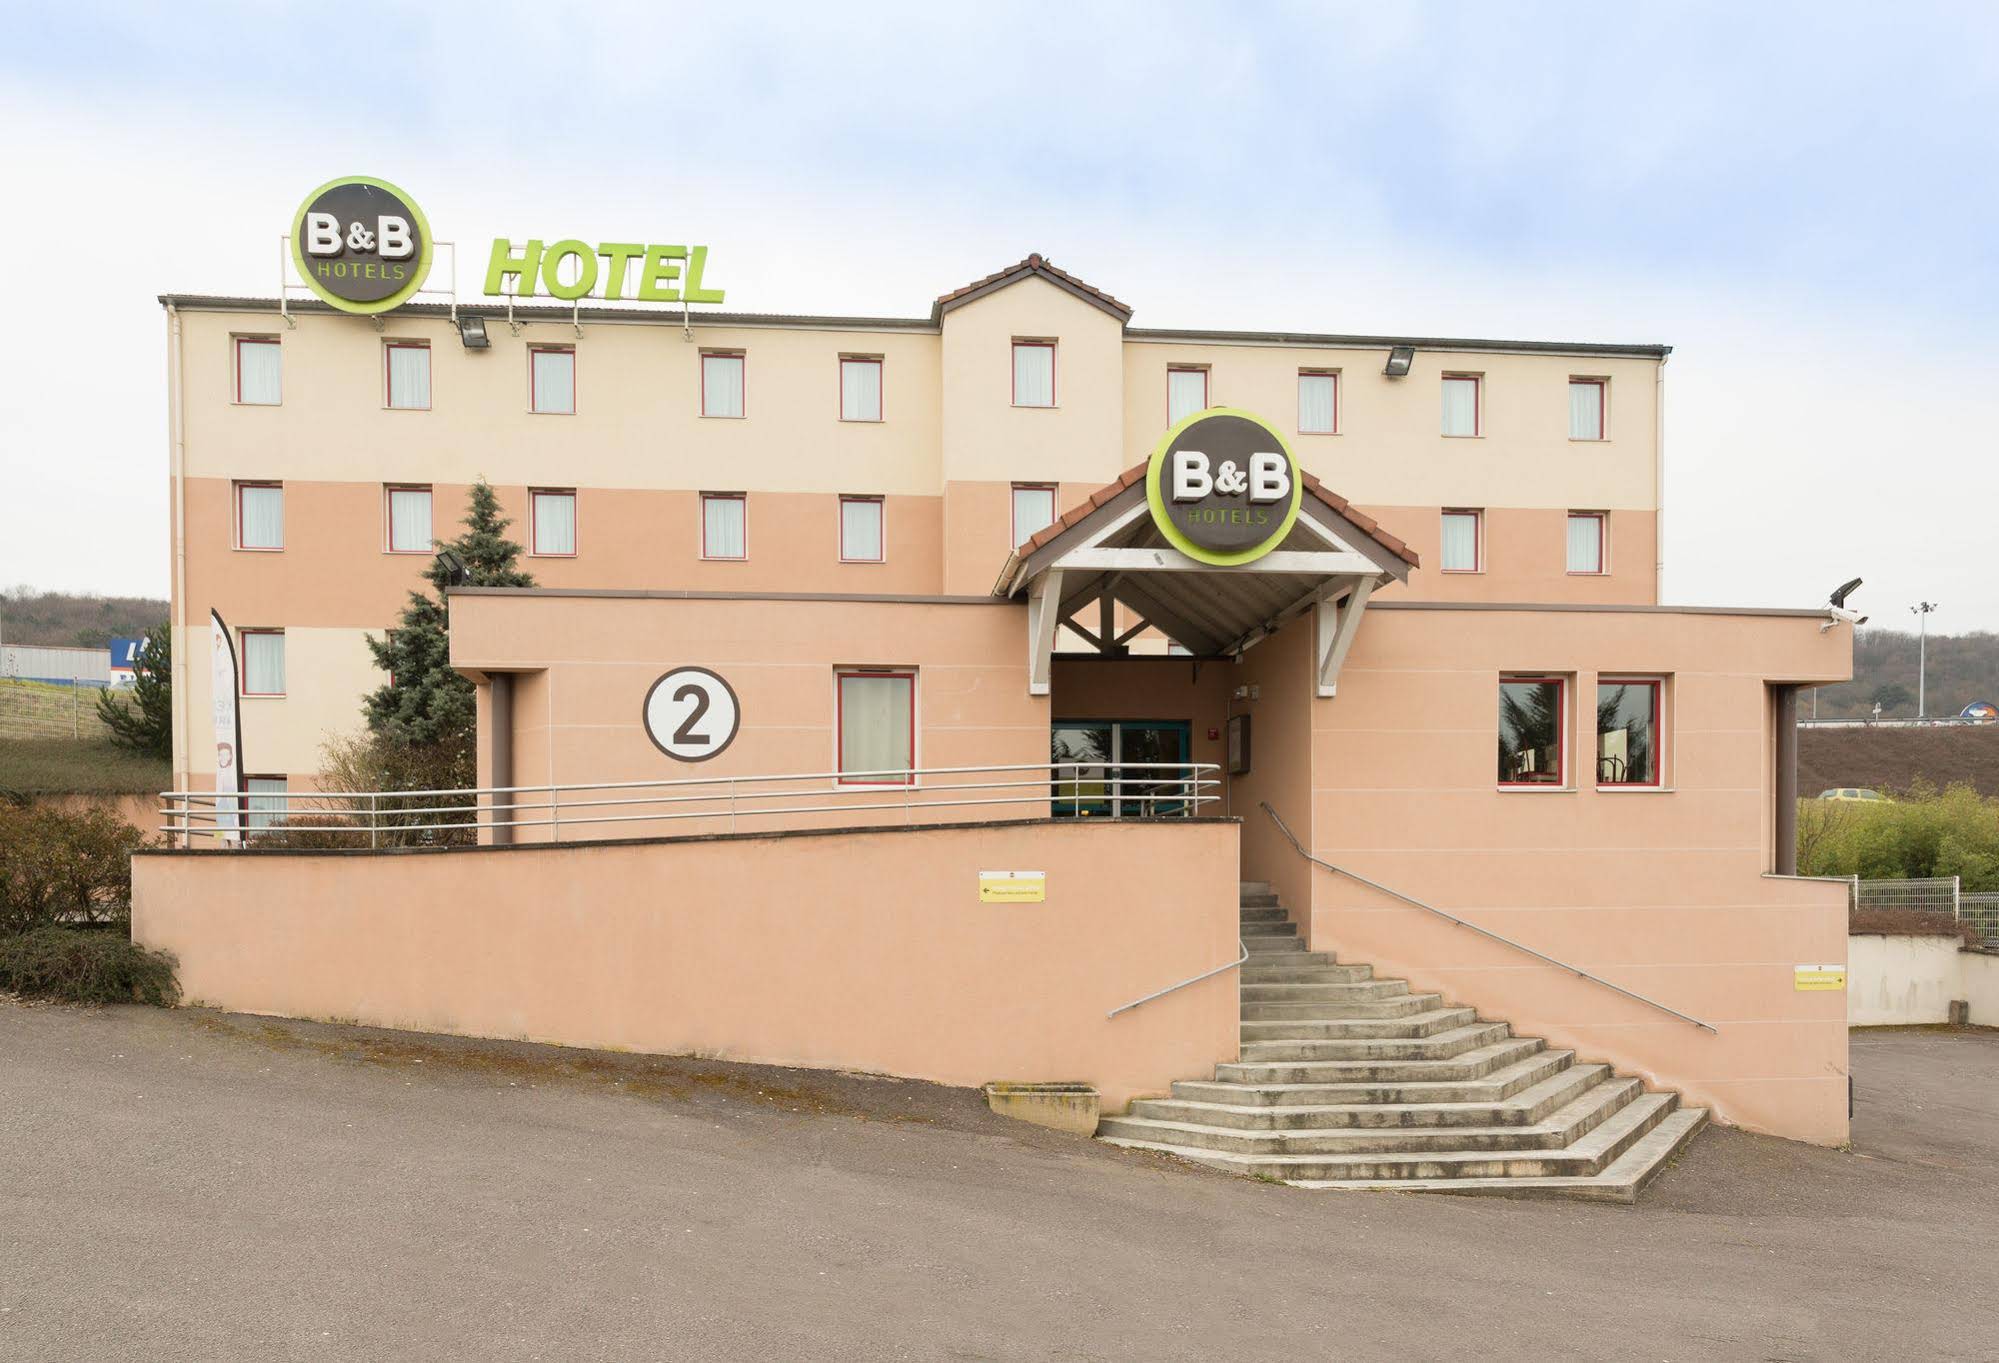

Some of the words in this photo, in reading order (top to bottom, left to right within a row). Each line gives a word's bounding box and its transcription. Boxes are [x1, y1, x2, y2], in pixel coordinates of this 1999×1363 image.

[307, 212, 414, 259] B&B
[318, 262, 405, 280] HOTELS
[483, 238, 726, 304] HOTEL
[1173, 451, 1290, 503] B&B
[1188, 508, 1269, 525] HOTELS
[673, 684, 710, 744] 2
